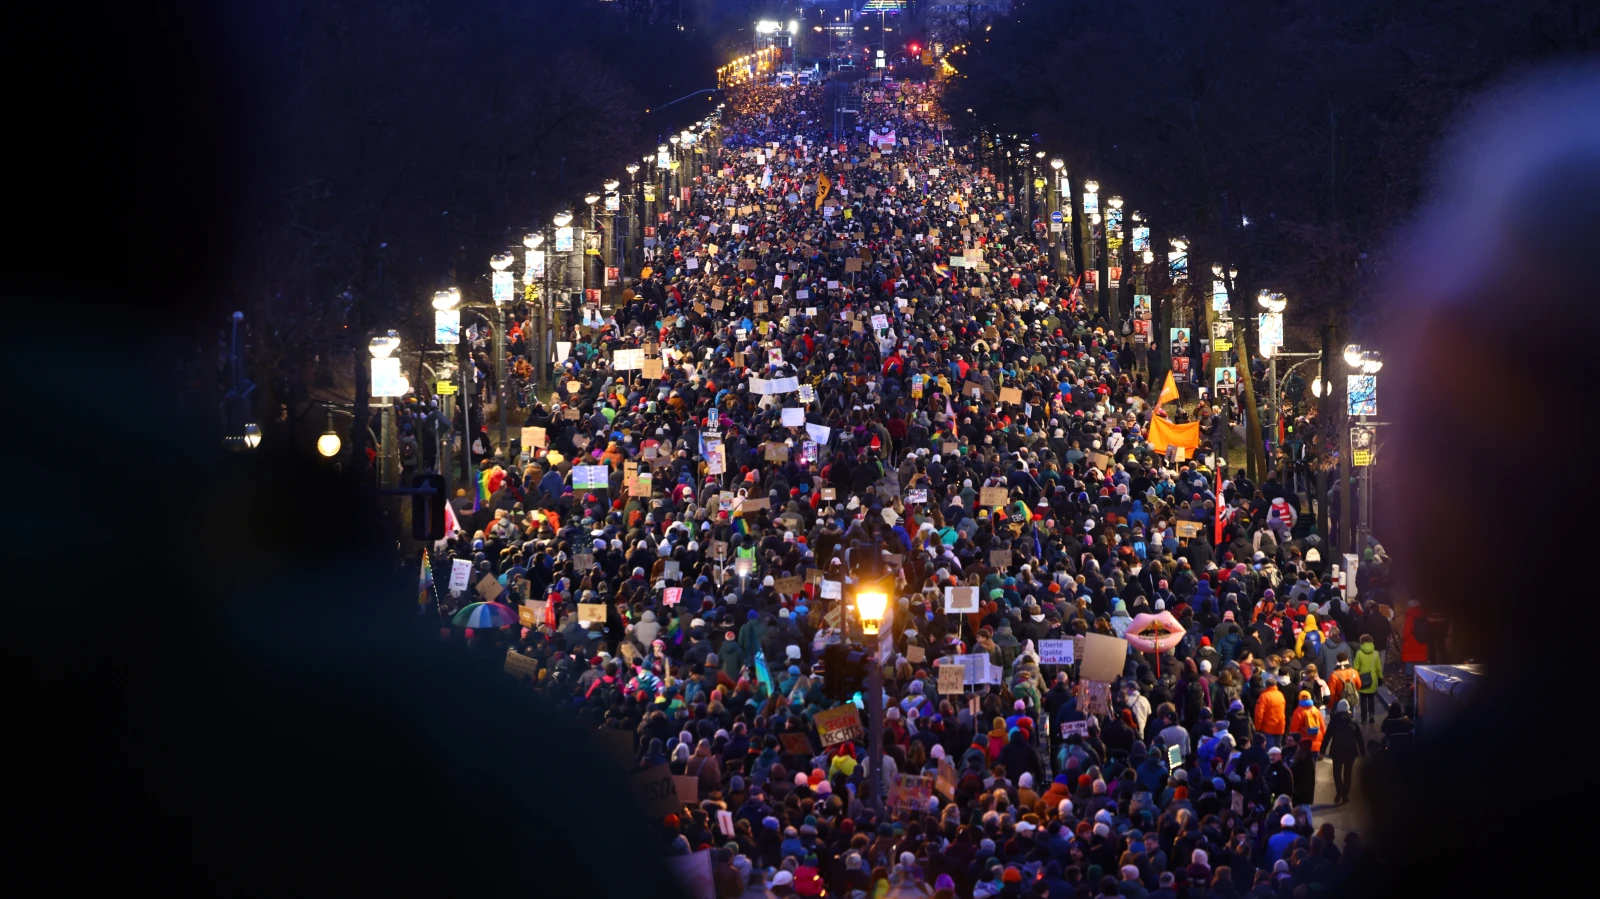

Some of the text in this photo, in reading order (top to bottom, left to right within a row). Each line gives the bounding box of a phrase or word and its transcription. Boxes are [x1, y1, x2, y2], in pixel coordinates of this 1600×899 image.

[1040, 648, 1062, 656] Egalité
[824, 716, 857, 731] GEGEN
[823, 725, 861, 744] RECHTS
